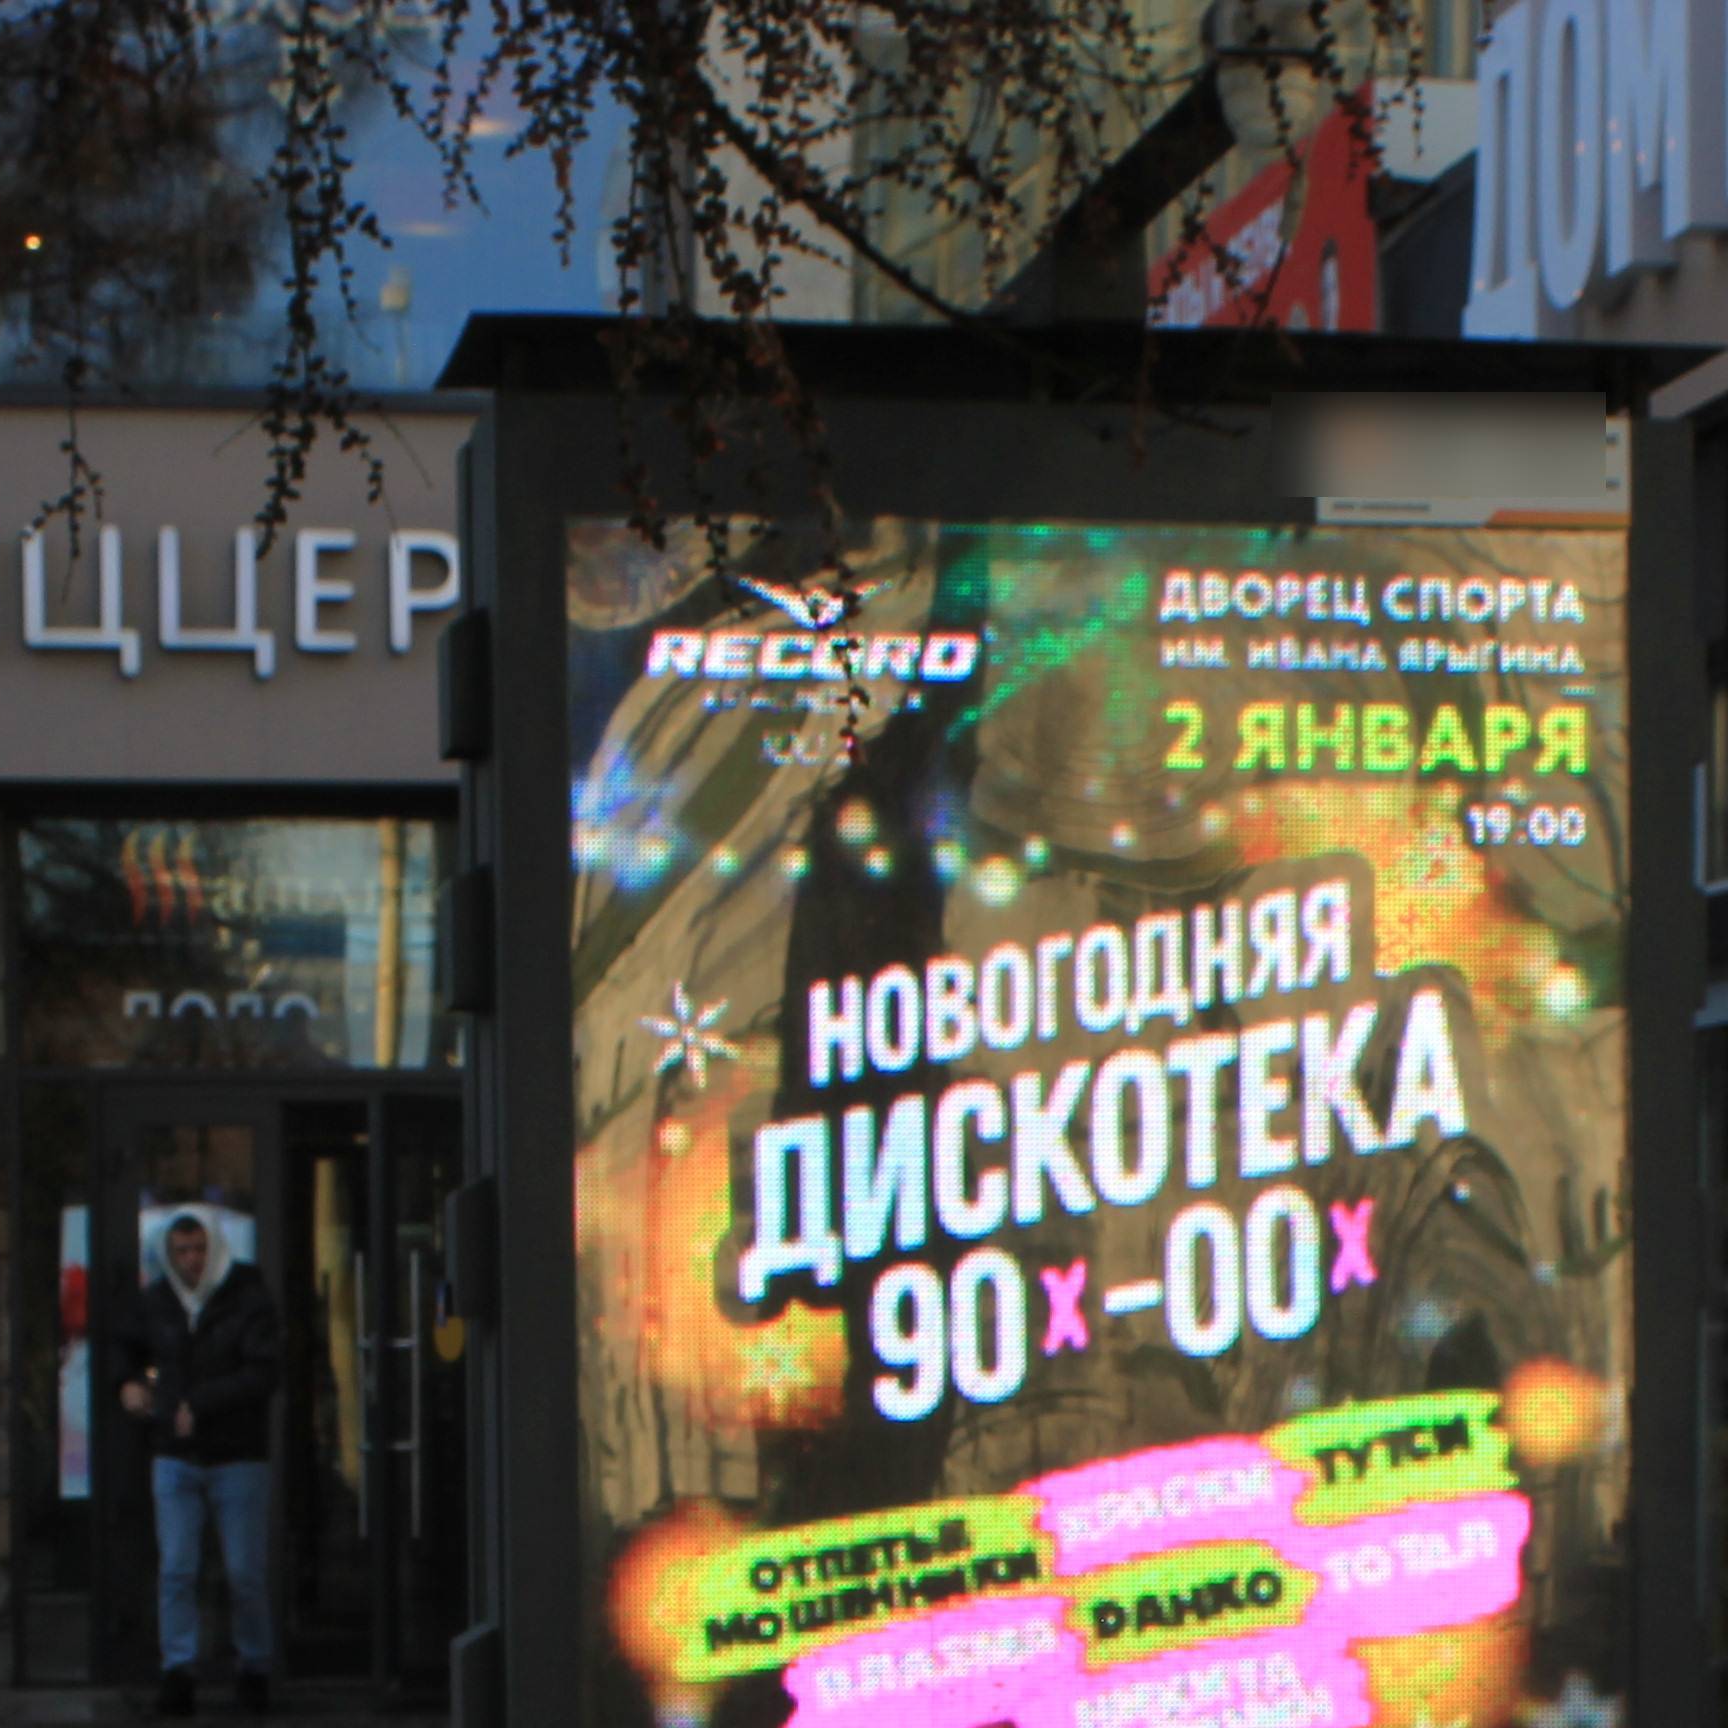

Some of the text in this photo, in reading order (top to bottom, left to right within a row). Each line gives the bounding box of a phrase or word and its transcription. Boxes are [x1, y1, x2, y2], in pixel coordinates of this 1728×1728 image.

[1462, 0, 1692, 338] ДОМ
[1158, 567, 1586, 628] ДВОРЕЦ СПОРТА
[644, 627, 981, 684] RECORD
[1162, 699, 1591, 775] 2 ЯНВАРЯ
[1467, 804, 1588, 848] 19:00
[807, 879, 1352, 1088] НОВОГОДНЯЯ
[737, 986, 1469, 1303] ДИСКОТЕКА
